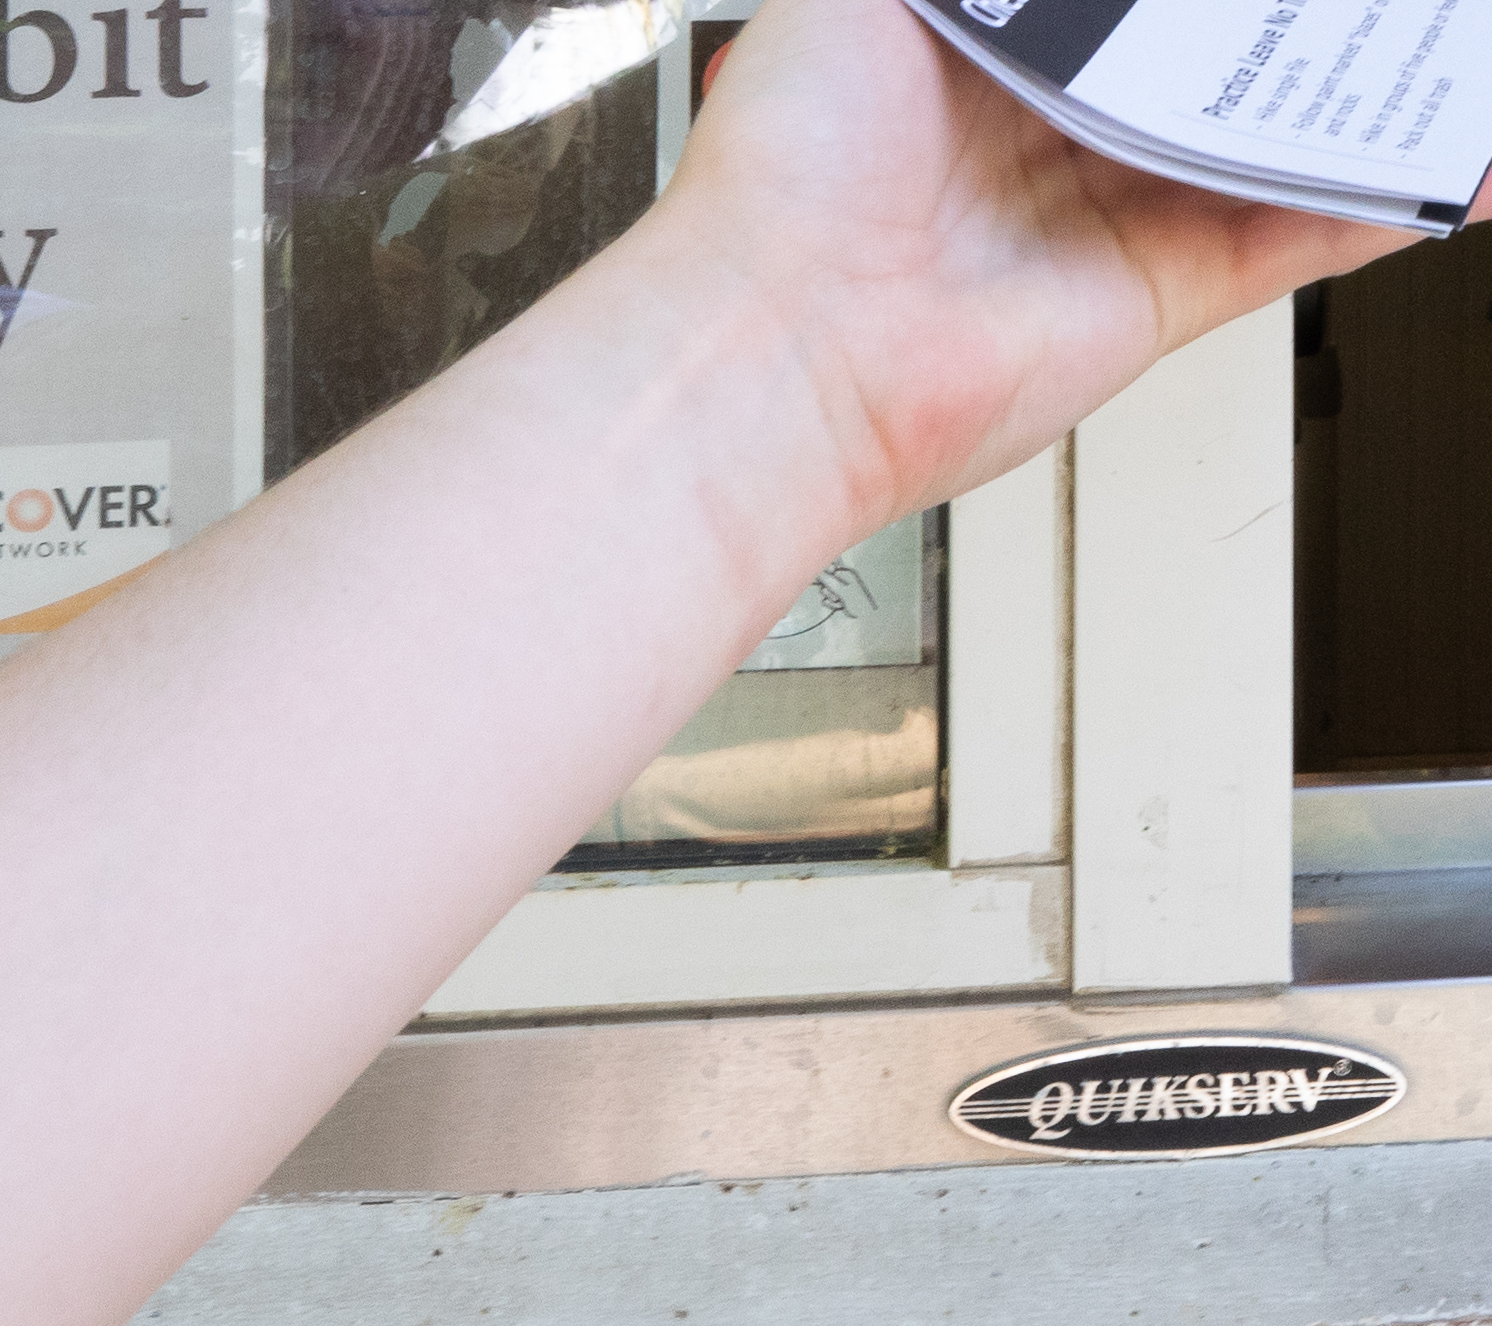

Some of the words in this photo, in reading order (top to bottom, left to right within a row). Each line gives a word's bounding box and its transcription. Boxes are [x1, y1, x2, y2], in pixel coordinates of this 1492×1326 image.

[1201, 67, 1259, 121] Practice
[1237, 29, 1285, 67] Leave
[1263, 8, 1299, 29] No
[1027, 1067, 1333, 1140] QUIKSERV
